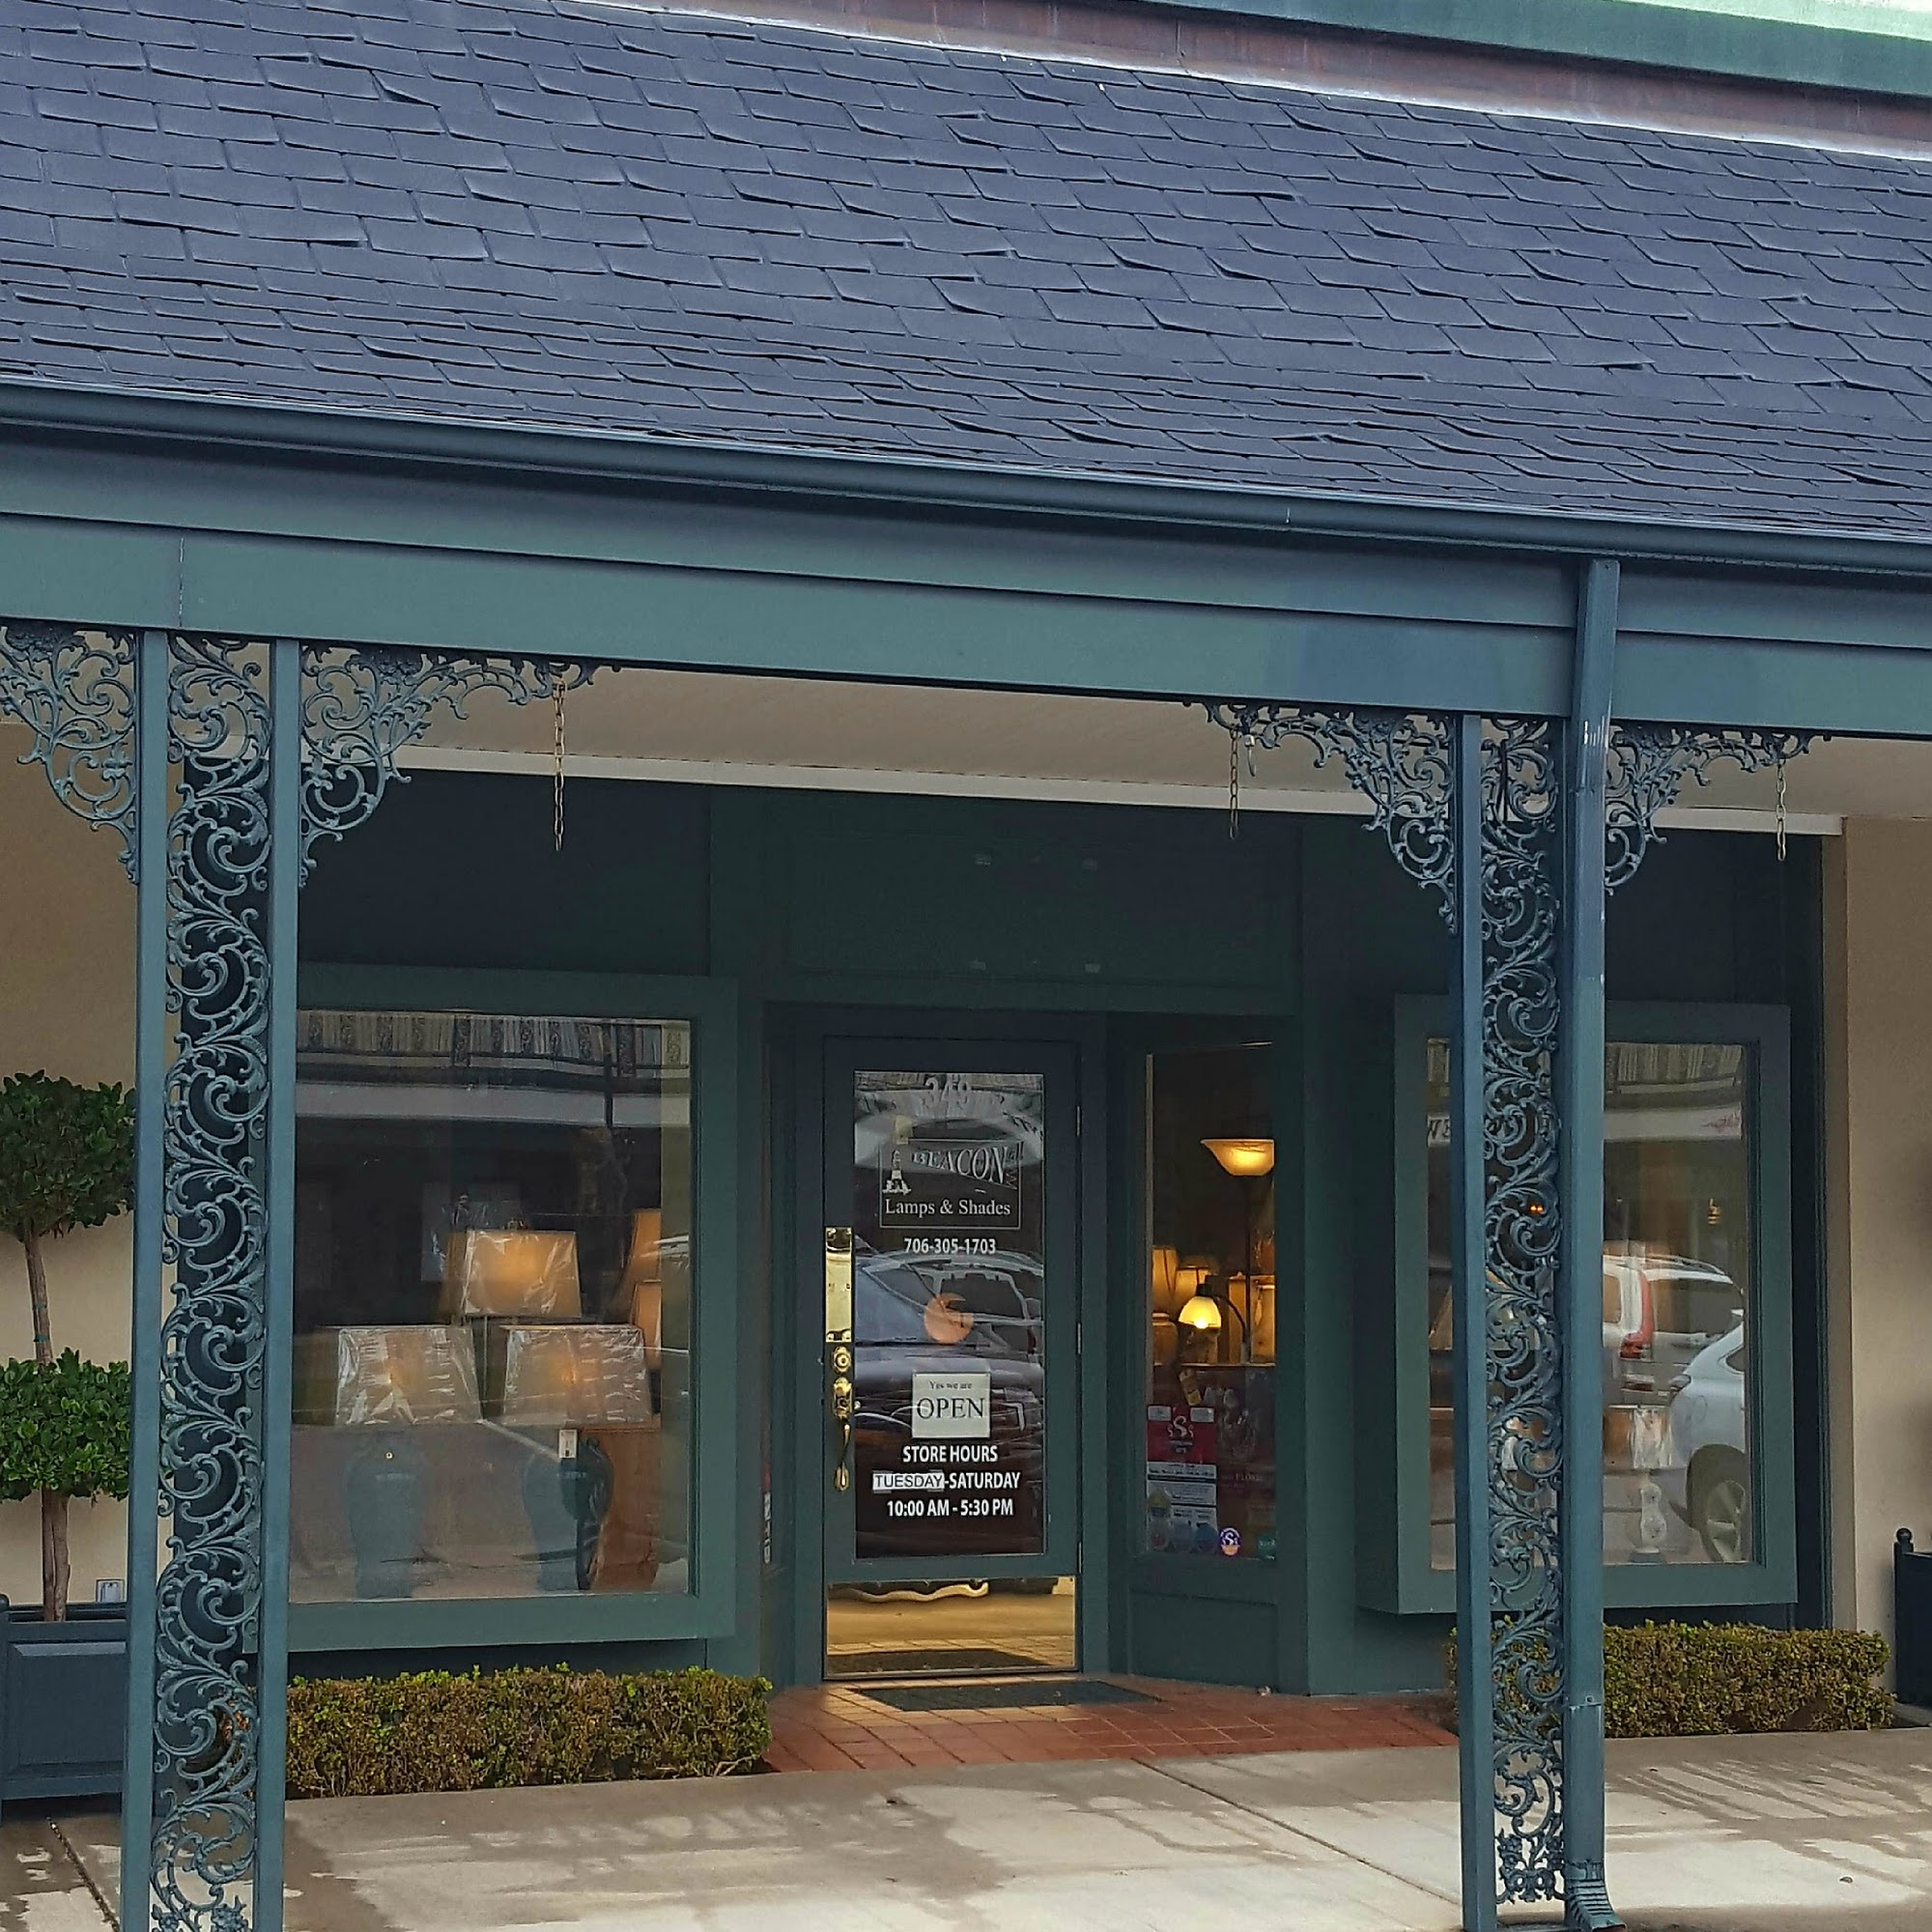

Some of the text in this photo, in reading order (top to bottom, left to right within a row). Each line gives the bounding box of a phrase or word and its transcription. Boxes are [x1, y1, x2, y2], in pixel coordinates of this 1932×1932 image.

[911, 1147, 1009, 1184] BEACON
[885, 1199, 1010, 1218] Lamps & Shades
[904, 1237, 996, 1254] 706-305-1703
[929, 1380, 944, 1390] Yes
[918, 1398, 985, 1419] OPEN
[903, 1445, 998, 1463] STORE HOURS
[887, 1500, 924, 1517] 10:00
[927, 1500, 950, 1517] AM
[960, 1499, 989, 1517] 5:30
[992, 1499, 1013, 1516] PM
